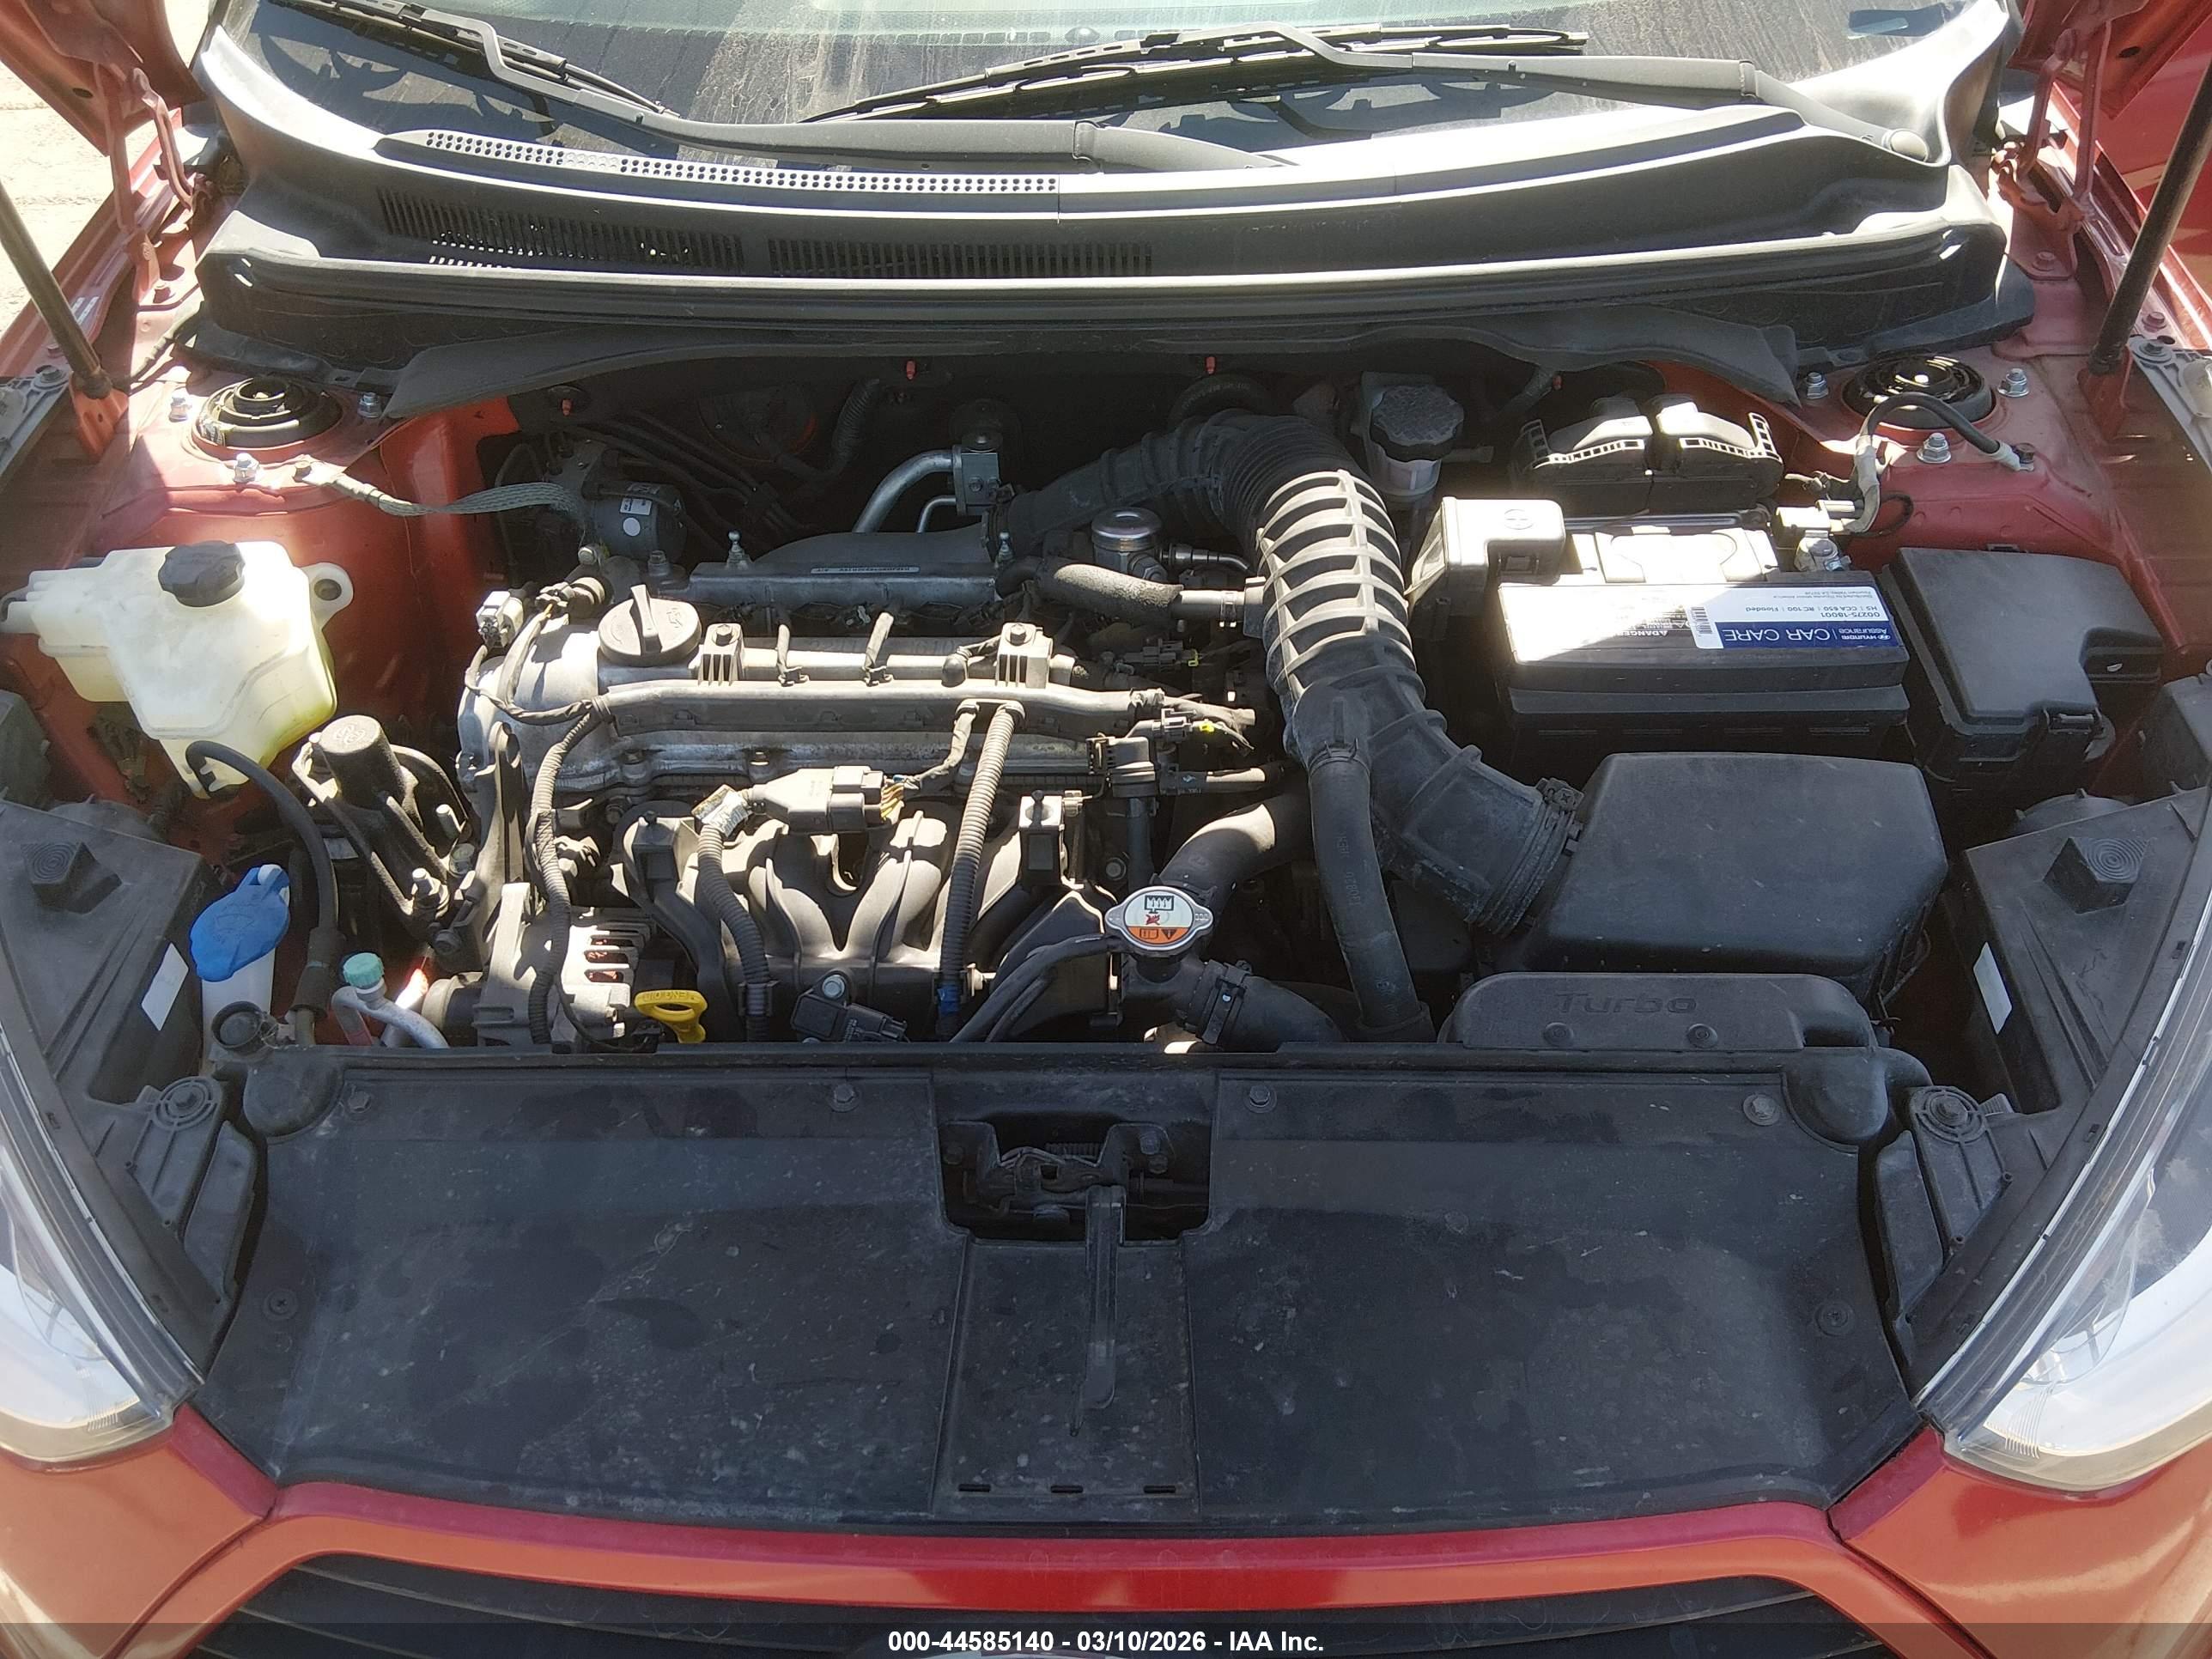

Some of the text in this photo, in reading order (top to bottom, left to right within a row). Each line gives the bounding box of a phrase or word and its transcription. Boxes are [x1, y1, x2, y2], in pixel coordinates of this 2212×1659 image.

[1721, 628, 1830, 641] CAR CARE
[1554, 991, 1697, 1014] Turbo
